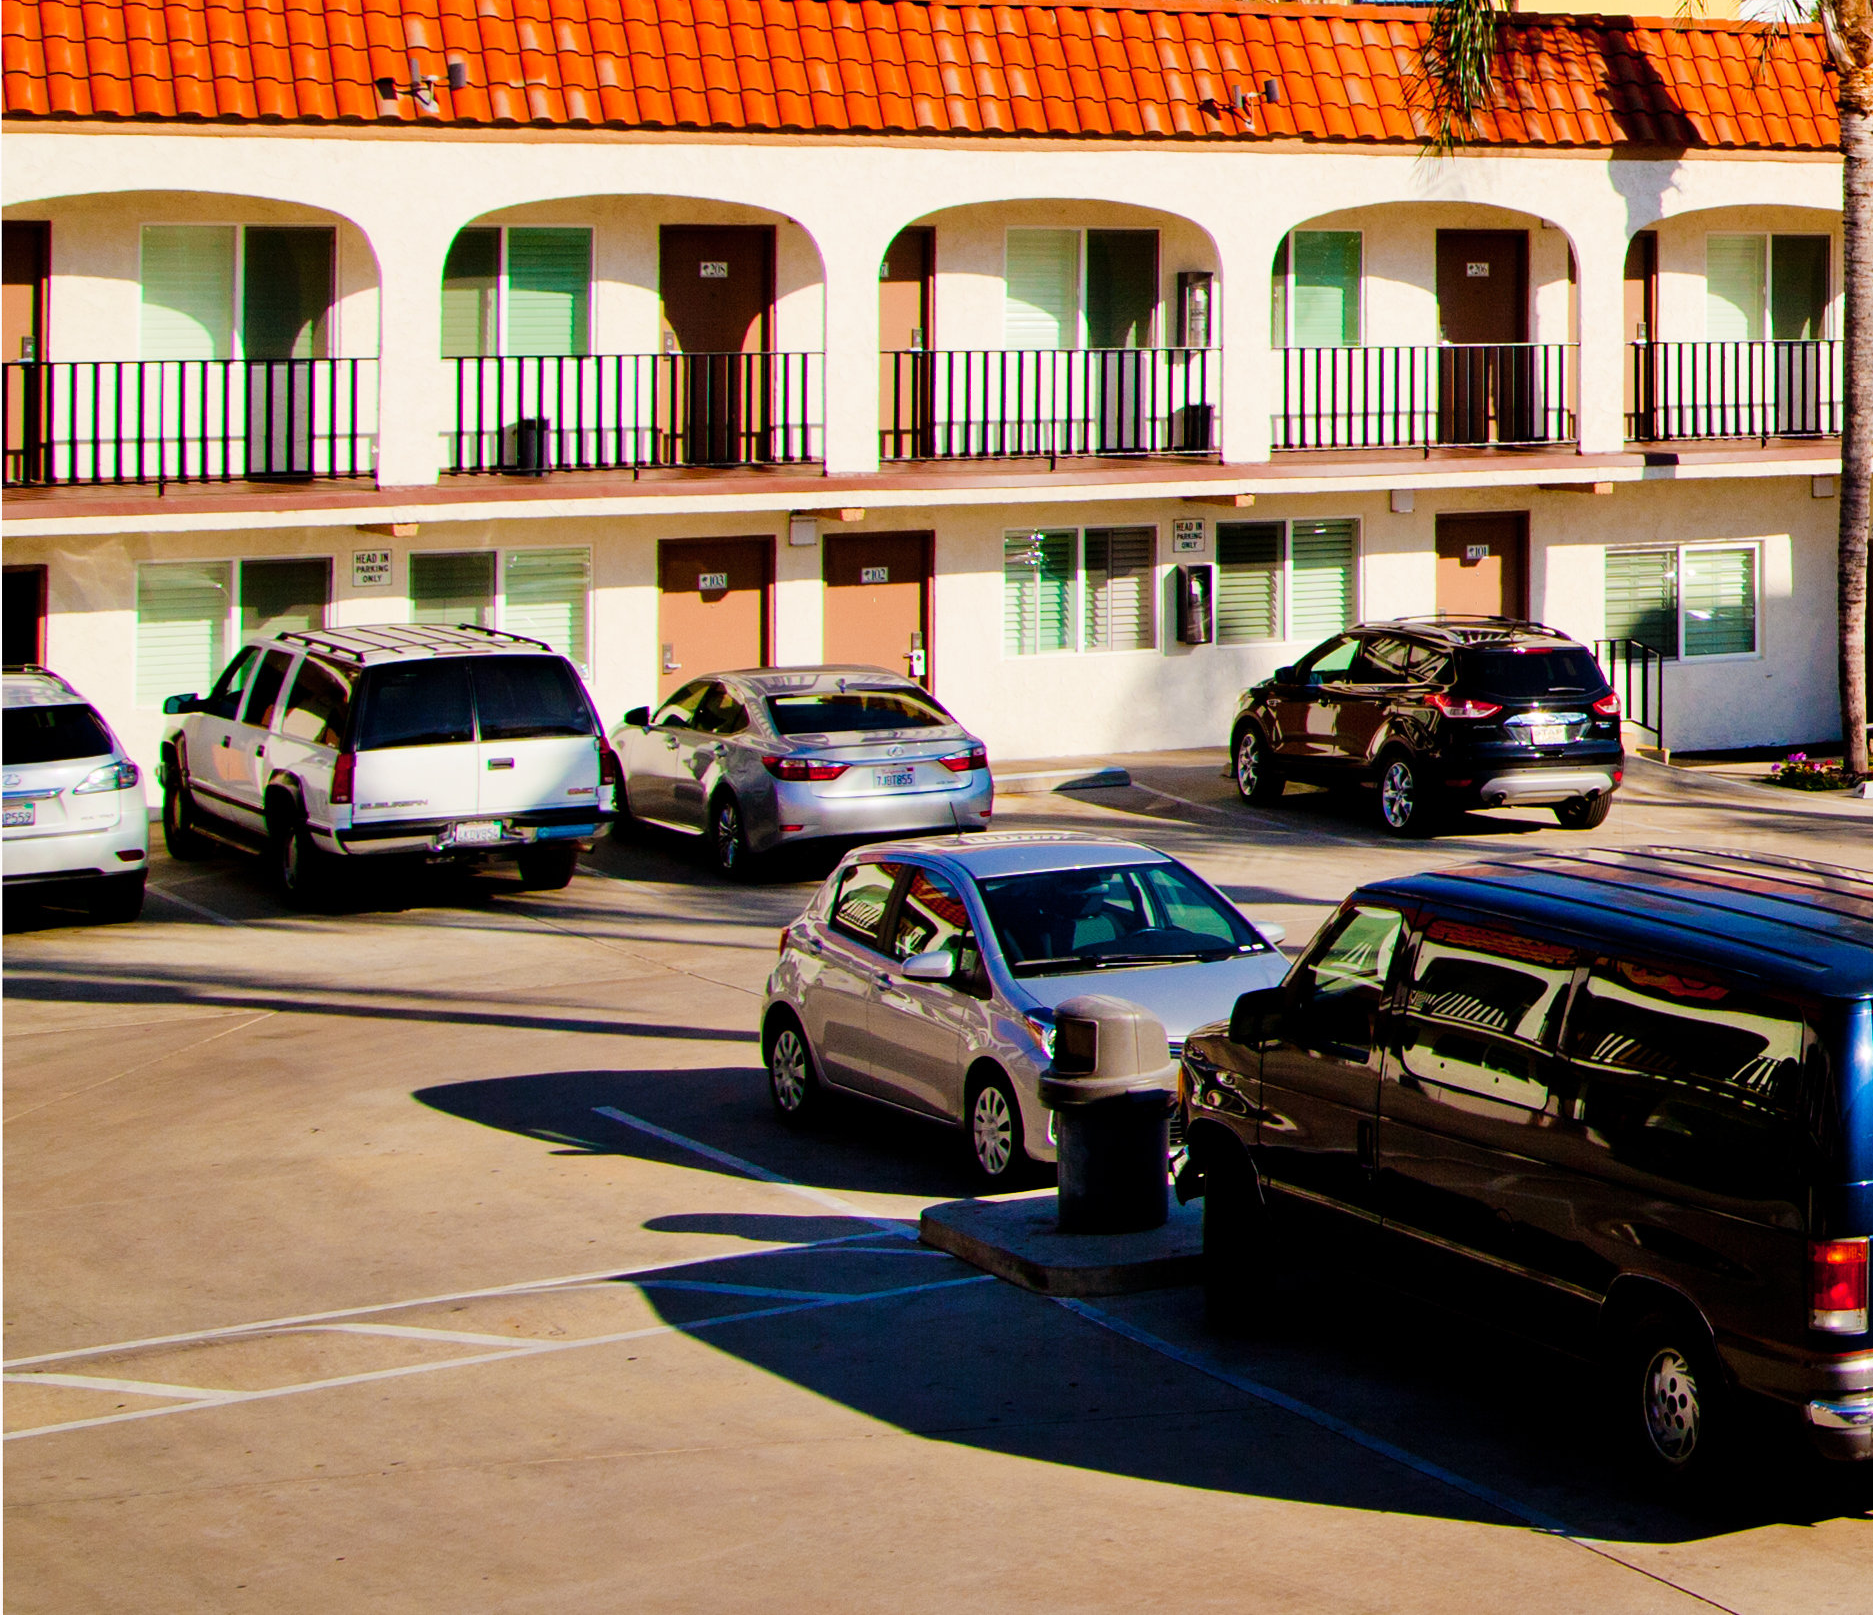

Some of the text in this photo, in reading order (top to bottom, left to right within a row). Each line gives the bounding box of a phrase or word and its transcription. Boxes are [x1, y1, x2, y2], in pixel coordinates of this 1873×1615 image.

[1176, 521, 1203, 531] HEAD IN
[355, 552, 389, 564] HEAD IN
[355, 564, 389, 574] PARKING
[361, 574, 382, 583] ONLY
[2, 811, 33, 824] P559
